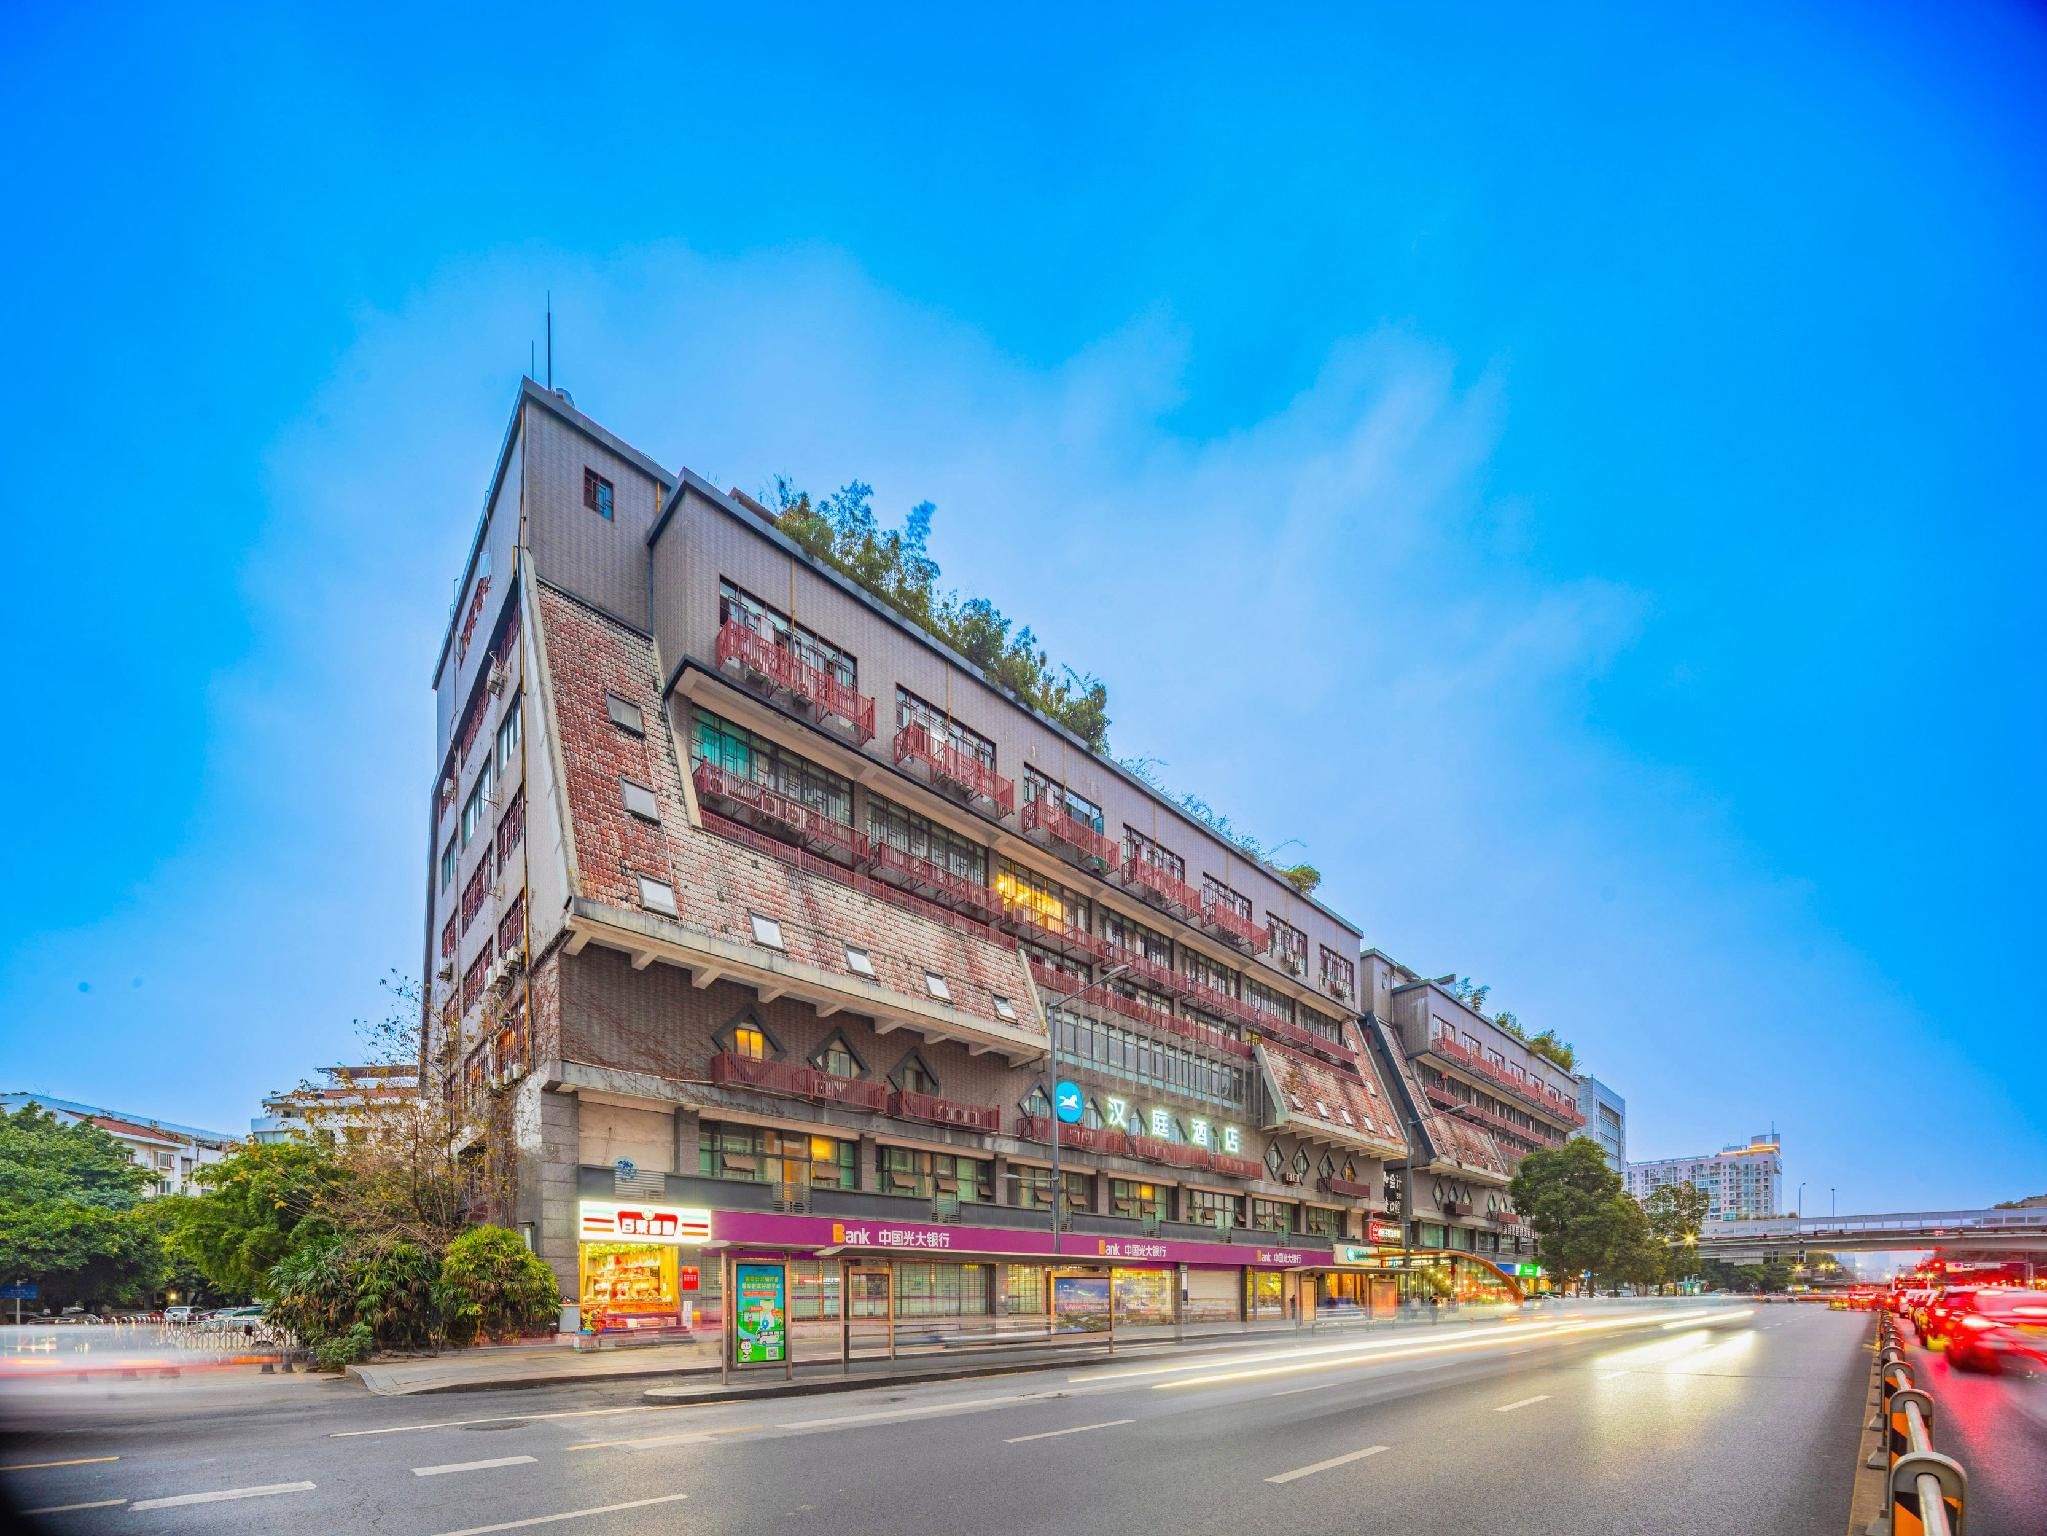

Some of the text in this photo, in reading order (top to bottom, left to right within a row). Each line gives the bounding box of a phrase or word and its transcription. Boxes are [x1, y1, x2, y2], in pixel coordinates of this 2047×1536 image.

[1106, 1096, 1239, 1152] 汉庭酒店
[832, 1223, 950, 1247] Bank 中国光大银行
